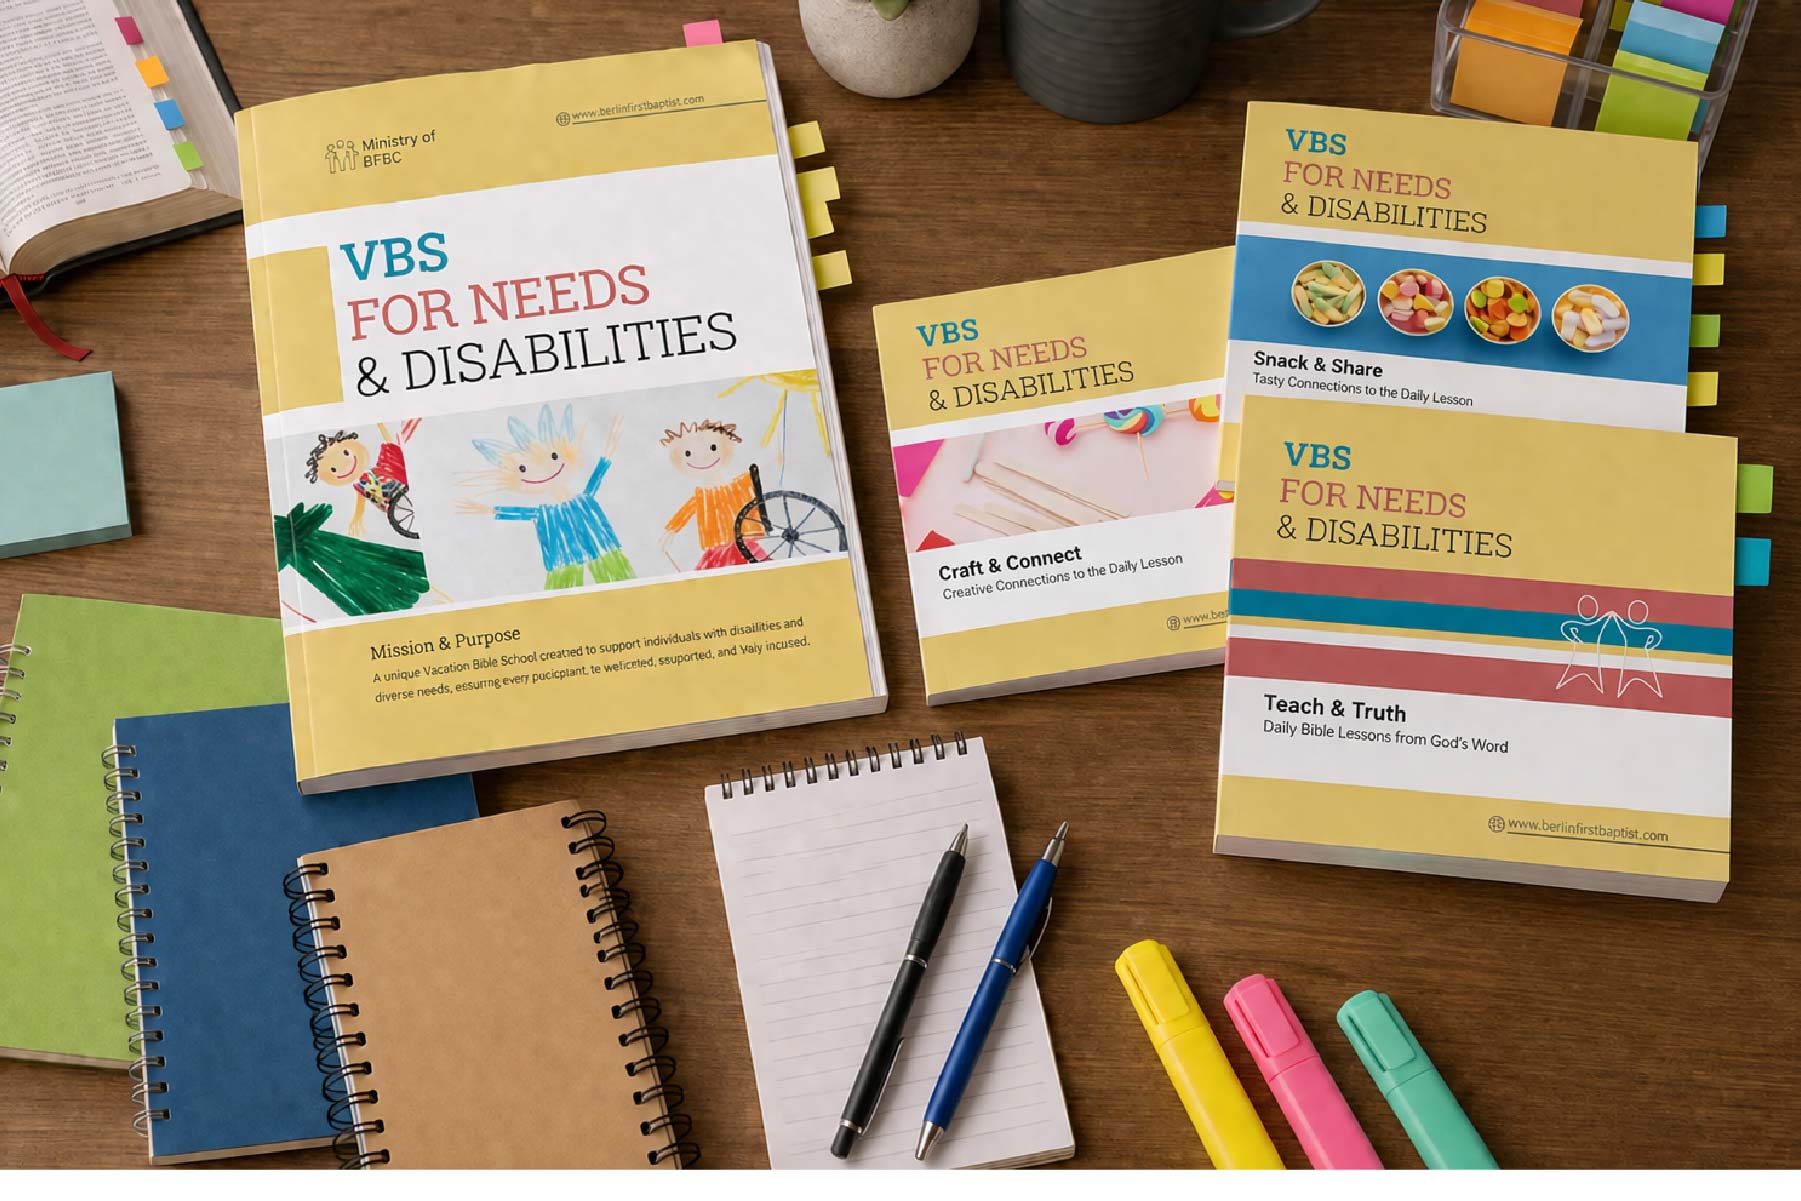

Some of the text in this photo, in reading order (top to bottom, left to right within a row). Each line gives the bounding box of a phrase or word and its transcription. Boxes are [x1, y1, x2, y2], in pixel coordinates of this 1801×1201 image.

[362, 129, 436, 152] Ministry of
[1285, 128, 1347, 156] VBS
[363, 152, 402, 168] BFBC
[1283, 160, 1452, 200] FOR NEEDS
[1281, 192, 1488, 234] & DISABILITIES
[340, 232, 448, 281] VBS
[347, 263, 650, 342] FOR NEEDS
[916, 318, 979, 347] VBS
[357, 312, 738, 398] & DISABILITIES
[922, 336, 1088, 381] FOR NEEDS
[1254, 351, 1384, 378] Snack & Share
[929, 360, 1134, 411] & DISABILITIES
[1252, 372, 1473, 406] Tasty Connections to the Daily Lesson
[1283, 440, 1351, 470] VBS
[1280, 478, 1466, 519] FOR NEEDS
[1276, 514, 1513, 559] & DISABILITIES
[938, 546, 1082, 581] Craft & Connect
[942, 554, 1184, 600] Creative Connections to the Daily Lesson
[370, 628, 522, 661] Mission & Purpose
[373, 672, 382, 684] A
[384, 668, 422, 684] unique
[423, 661, 470, 676] Vacation
[472, 655, 498, 670] Bible
[501, 650, 538, 666] School
[586, 645, 596, 656] to
[599, 638, 642, 656] support
[644, 631, 702, 647] individuals
[703, 626, 728, 641] with
[783, 616, 804, 630] and
[375, 688, 414, 704] diverse
[417, 683, 453, 698] needs,
[718, 645, 737, 658] and
[1264, 694, 1406, 722] Teach & Truth
[1263, 720, 1509, 754] Daily Bible Lessons from God's Word
[1508, 818, 1668, 842] www.berlinfirstbaptist.com
